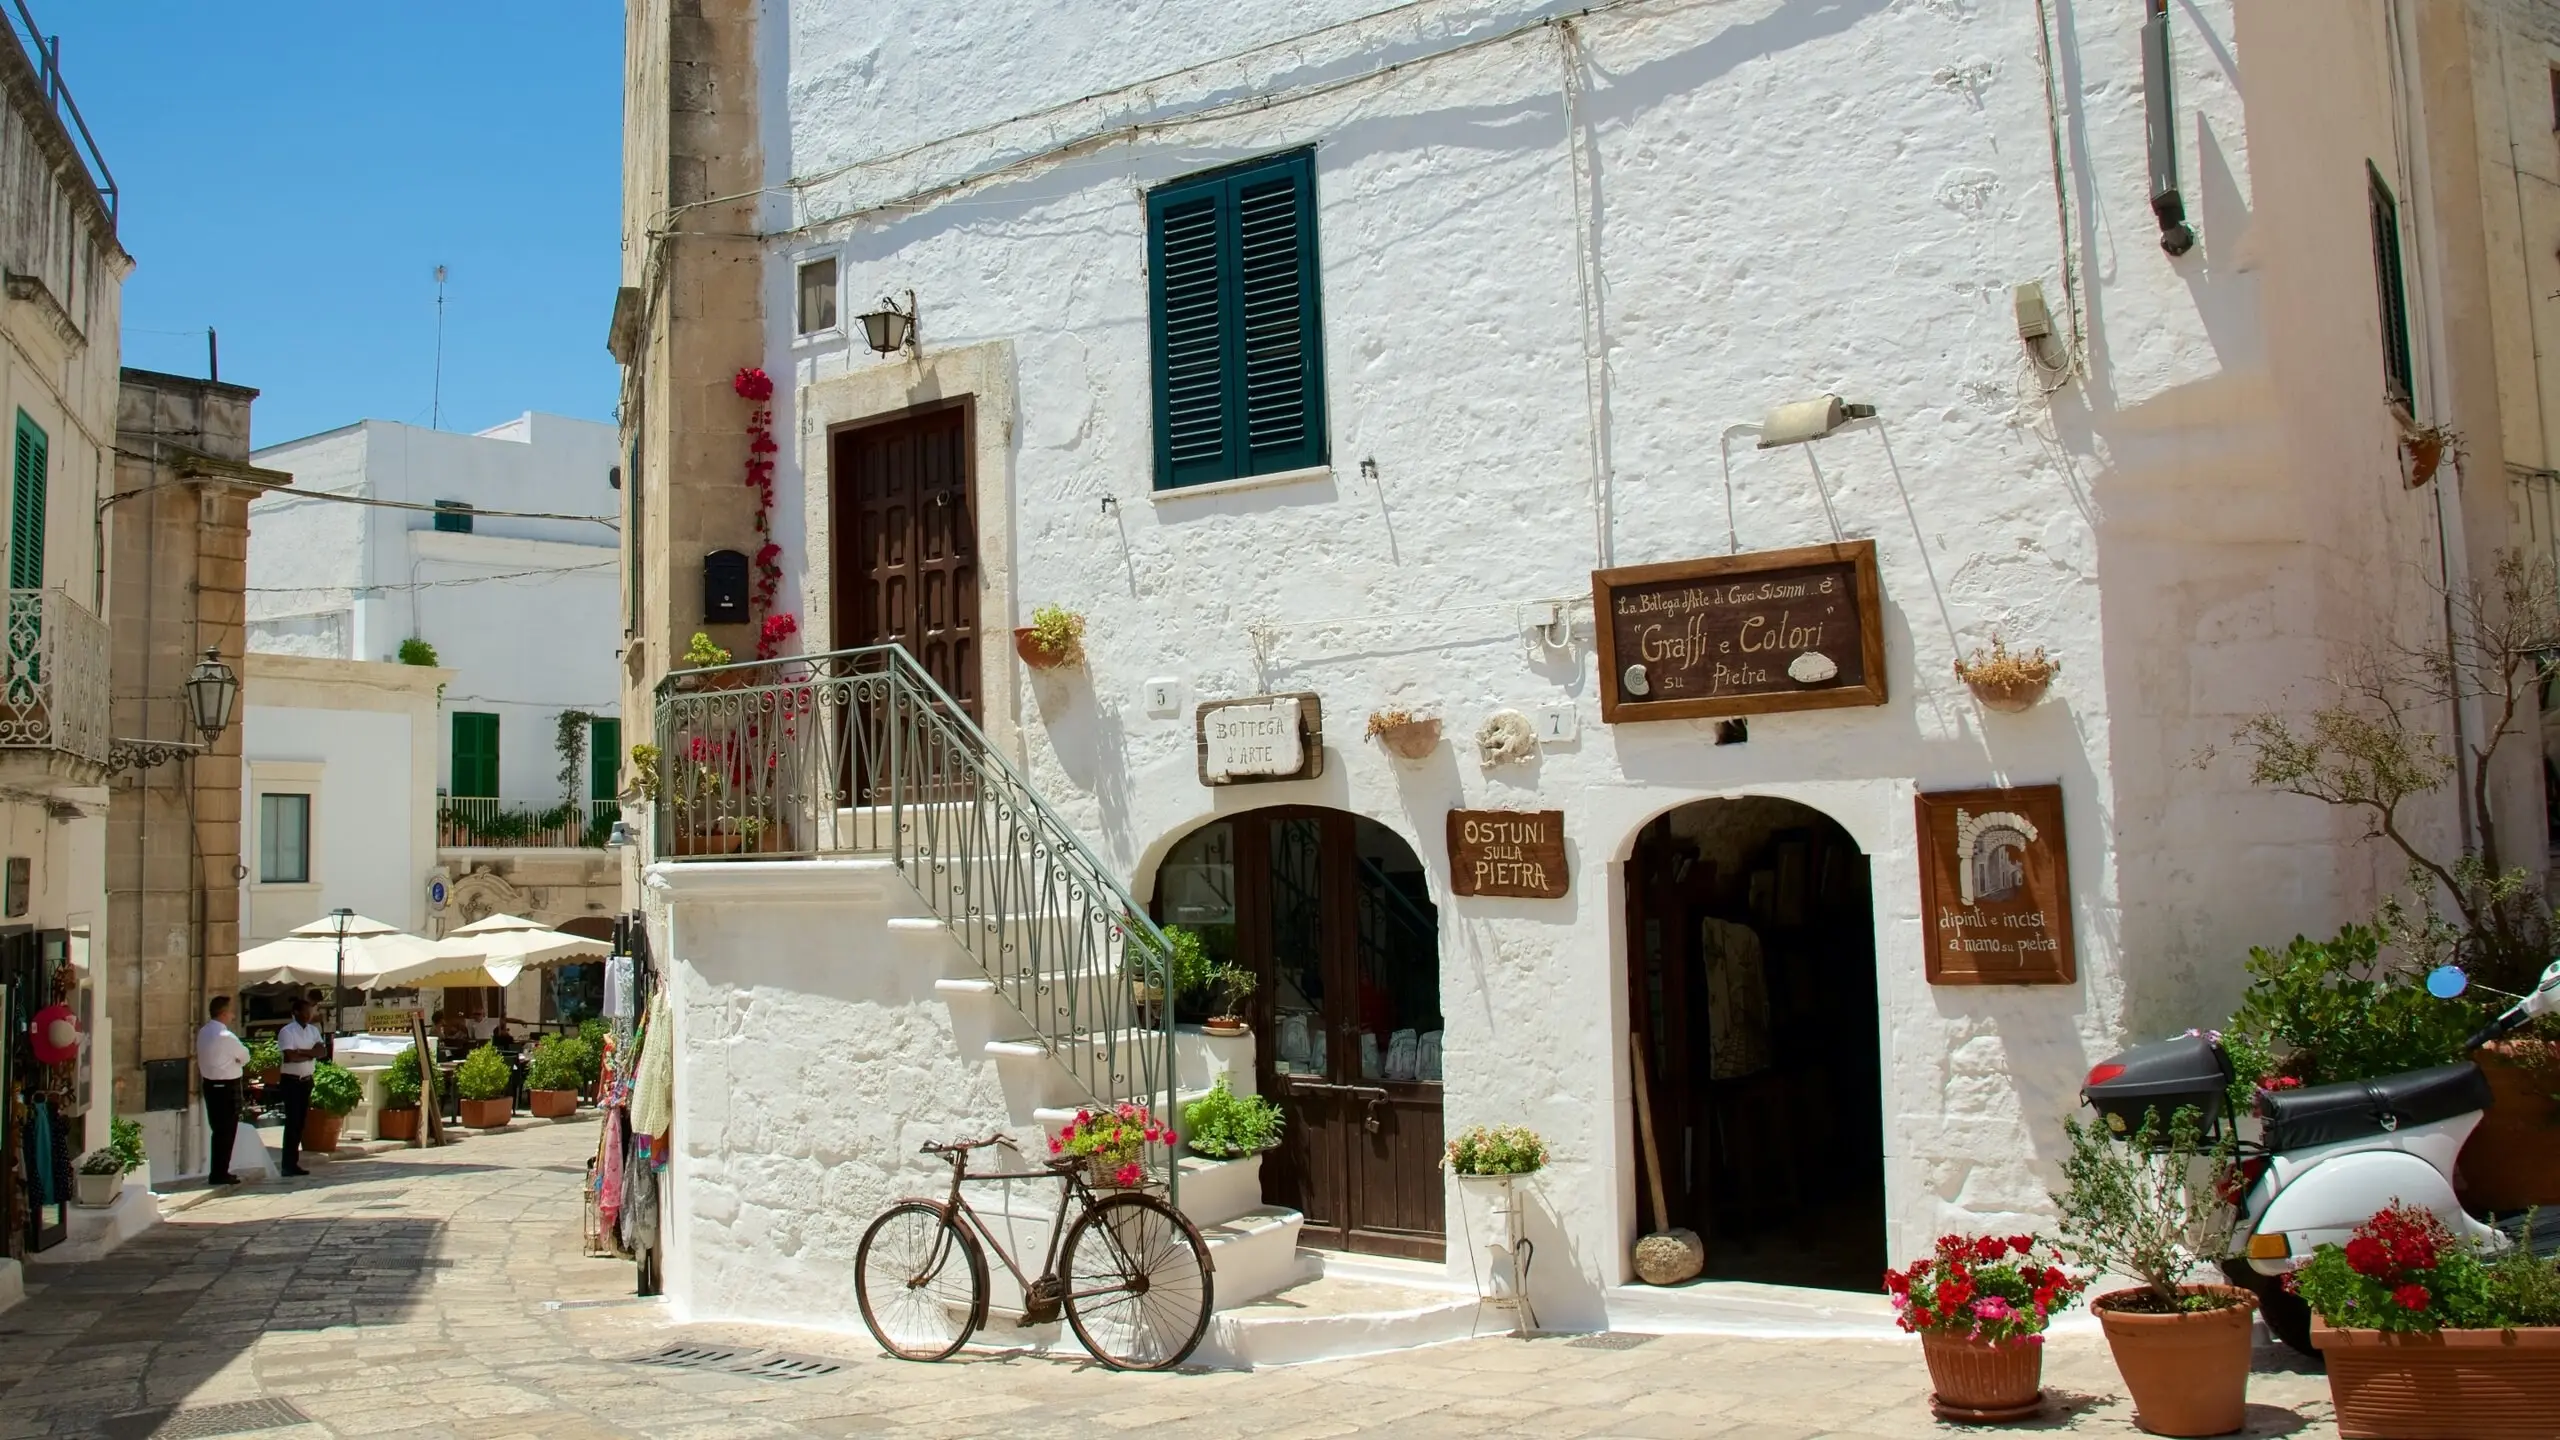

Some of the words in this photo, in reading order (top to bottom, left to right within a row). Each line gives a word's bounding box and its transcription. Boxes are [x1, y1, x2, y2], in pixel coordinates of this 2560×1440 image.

[1618, 596, 1637, 614] La
[1640, 593, 1680, 617] Bottega
[1715, 589, 1724, 604] di
[1719, 641, 1730, 654] e
[1663, 676, 1684, 689] su
[1157, 688, 1166, 706] 5
[1216, 718, 1285, 739] BOTTEGA
[1550, 713, 1560, 735] 7
[1464, 820, 1545, 844] OSTUNI
[1483, 846, 1523, 861] SULLA
[1474, 860, 1549, 891] PIETRA
[1940, 906, 1987, 937] dipinti
[1990, 916, 1999, 925] e
[2003, 910, 2046, 928] incisi
[1949, 939, 1961, 951] a
[1963, 939, 2000, 952] mano
[2001, 943, 2014, 952] su
[2017, 931, 2058, 967] pietra
